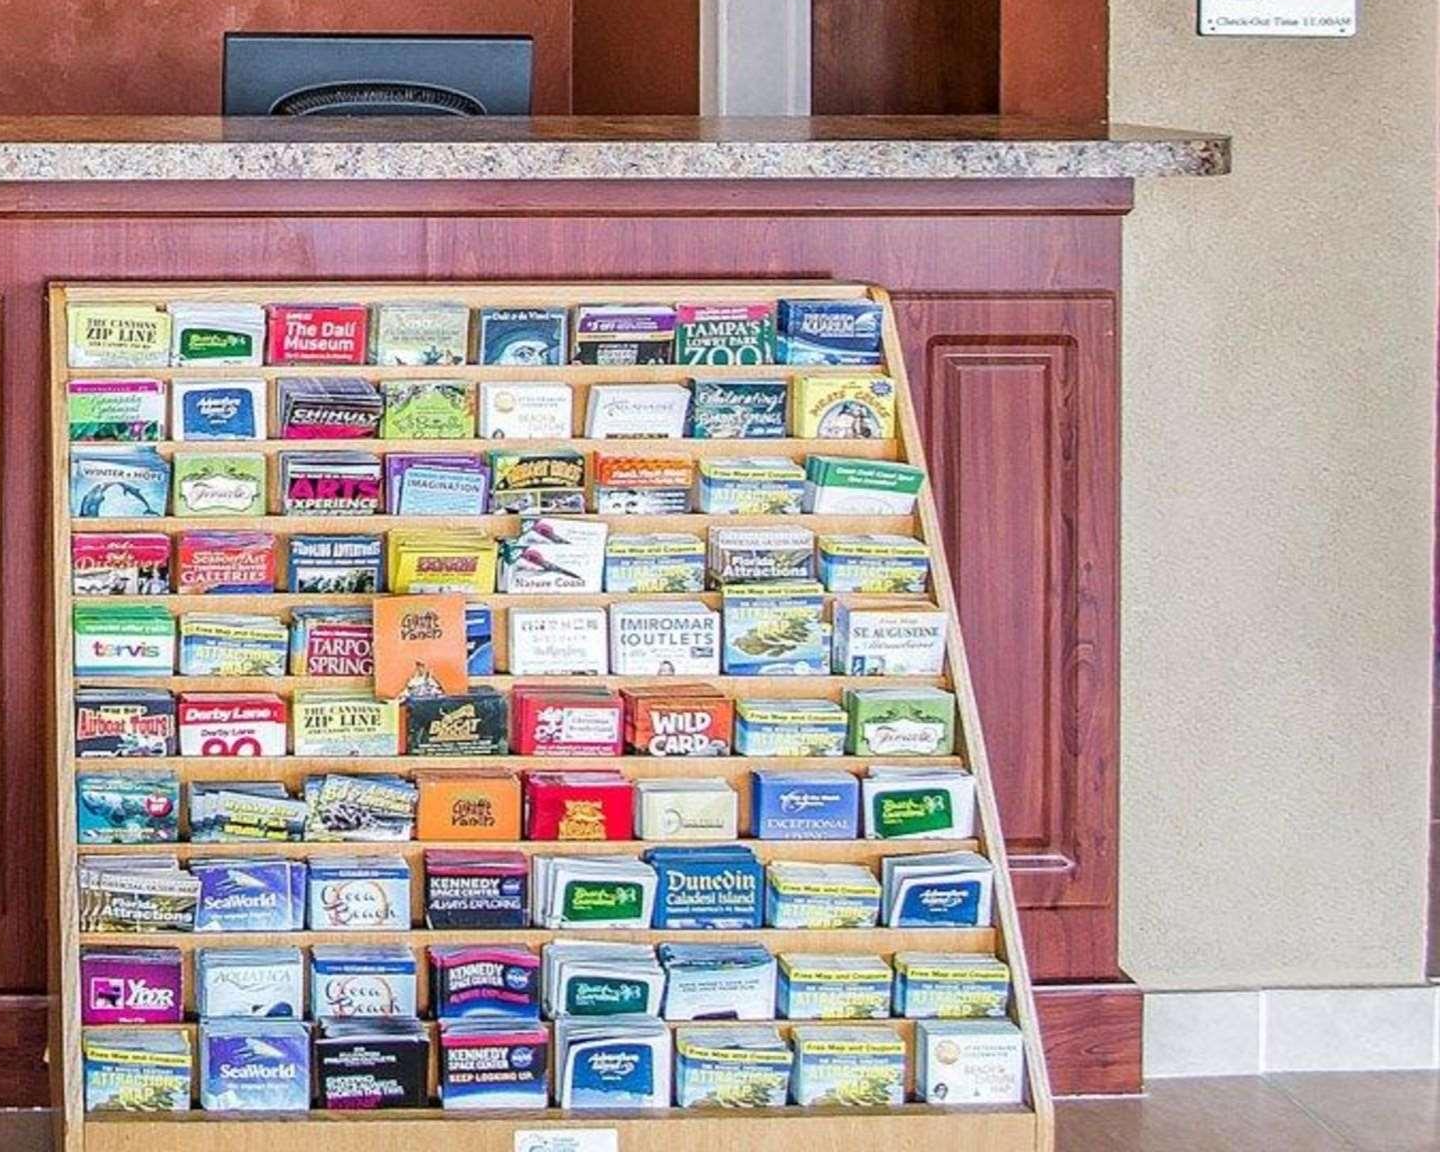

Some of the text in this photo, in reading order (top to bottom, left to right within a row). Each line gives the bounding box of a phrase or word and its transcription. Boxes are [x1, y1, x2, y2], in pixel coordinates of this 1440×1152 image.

[1217, 18, 1270, 26] Check-Out
[287, 322, 316, 336] The
[685, 322, 760, 337] TAMPA'S
[87, 329, 156, 343] ZIP LINE
[687, 337, 758, 346] LOWRY PARK
[285, 338, 354, 350] Museum
[687, 346, 762, 365] ZOO
[85, 469, 122, 477] WINTER
[291, 479, 380, 498] ARTS
[408, 480, 480, 494] IMAGINATION
[286, 499, 377, 508] EXPERIENCE
[733, 557, 774, 567] Florida
[182, 571, 265, 582] GALLERIES
[722, 566, 807, 577] Attractions
[515, 579, 586, 588] Nature Coast
[626, 619, 713, 630] MIROMAR
[874, 628, 939, 638] AUGUSTINE
[626, 634, 713, 646] OUTLETS
[93, 641, 159, 657] tervis
[311, 639, 374, 655] TARPO
[186, 708, 271, 722] Derby Lane
[80, 709, 168, 738] Airboat Tours
[305, 715, 380, 728] ZIP LINE
[649, 712, 711, 733] WILD
[650, 735, 709, 756] CARD
[767, 819, 849, 829] EXCEPTIONAL
[430, 878, 500, 889] KENNEDY
[667, 871, 754, 890] Dunedin
[430, 889, 460, 897] SPACE
[667, 893, 754, 904] Caladesi Island
[113, 898, 158, 909] Florida
[205, 893, 276, 909] SeaWorld
[430, 900, 521, 909] ALWAYS EXPLORING
[101, 906, 192, 921] Attractions
[449, 964, 504, 979] KENNEDY
[816, 972, 834, 980] Map
[853, 972, 887, 980] Coupons
[911, 970, 1005, 979] Free Map and Coupons
[449, 977, 502, 988] SPACE CENTER
[807, 1043, 825, 1051] Free
[866, 1043, 901, 1052] Coupons
[448, 1049, 508, 1061] KENNEDY
[689, 1049, 709, 1057] Free
[712, 1051, 729, 1059] Map
[476, 1061, 508, 1069] CENTER
[221, 1064, 295, 1079] SeaWorld
[92, 1074, 182, 1085] ATTRACTIONS
[449, 1074, 472, 1082] KEEP
